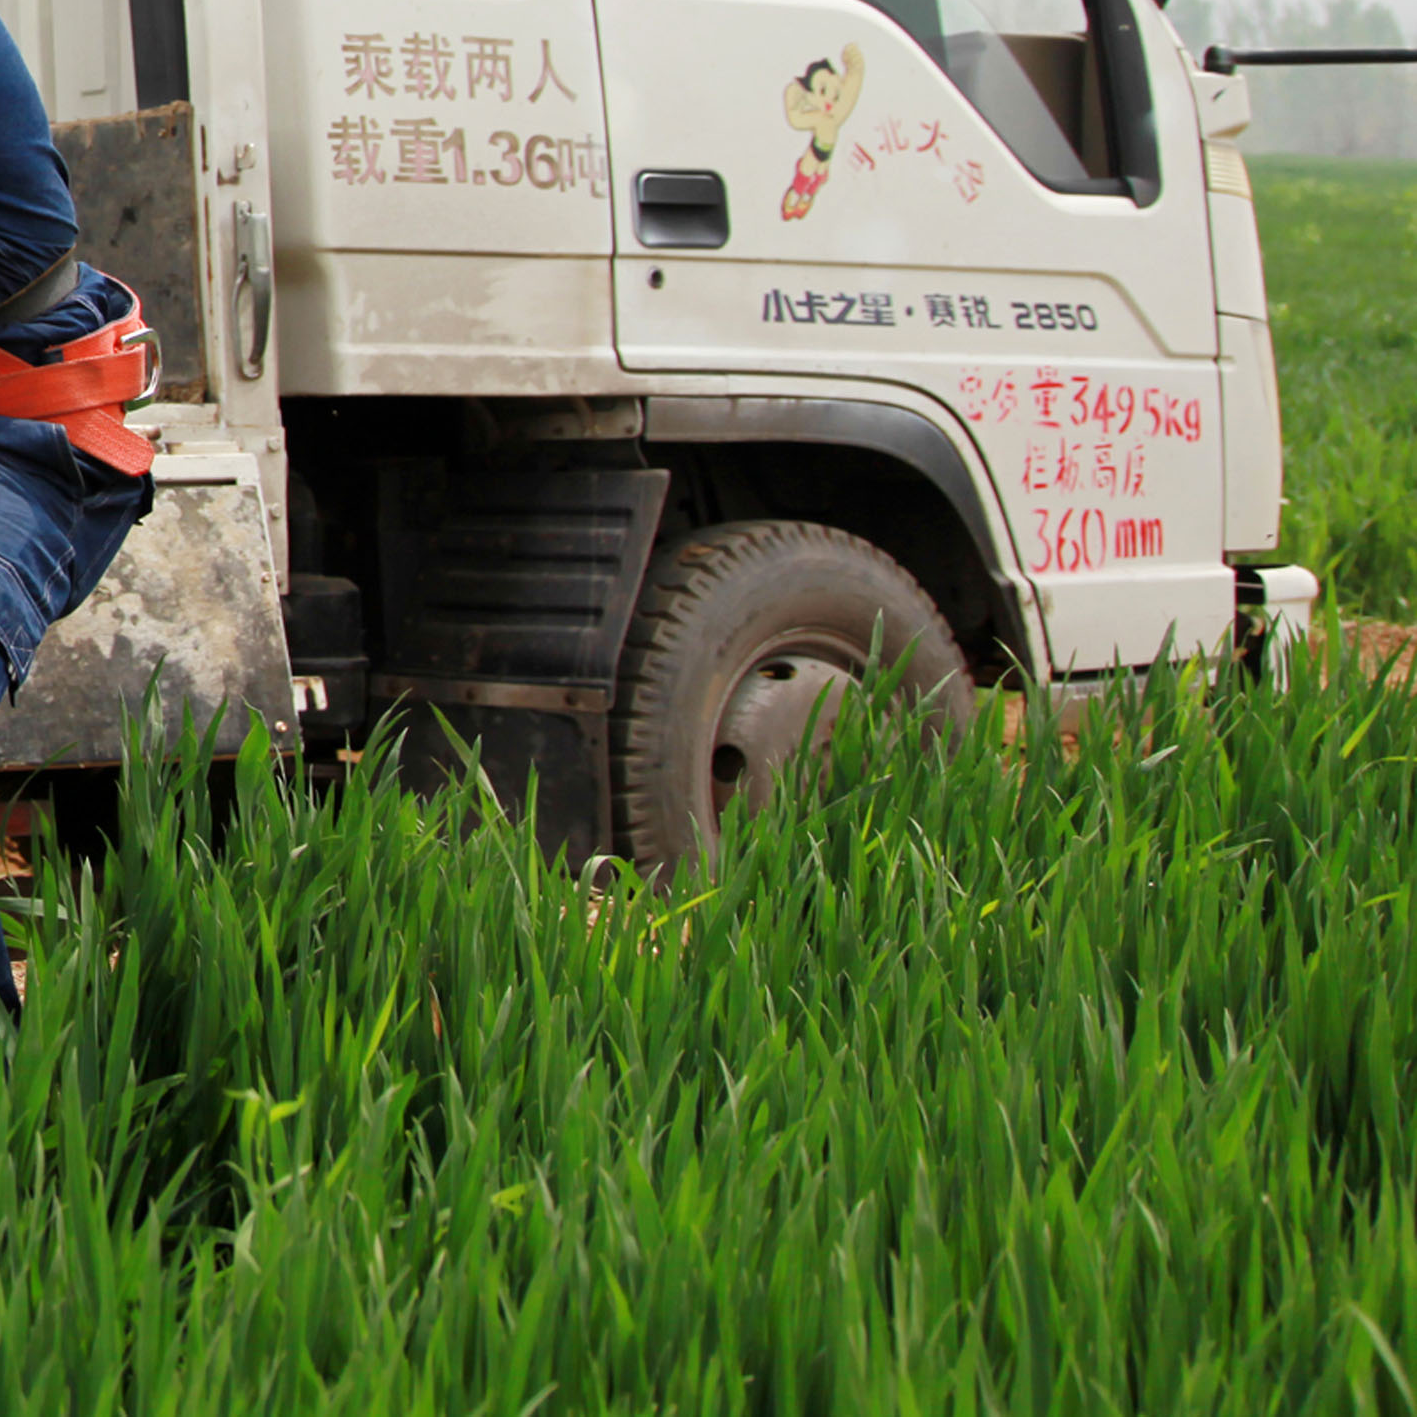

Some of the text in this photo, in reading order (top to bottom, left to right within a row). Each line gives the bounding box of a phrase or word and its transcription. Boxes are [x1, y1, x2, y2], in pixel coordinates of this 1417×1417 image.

[341, 32, 577, 103] 乘载两人
[327, 115, 609, 199] 载重1.36吨
[1011, 302, 1098, 331] 2850
[960, 365, 1201, 442] 总质量3495kg
[1021, 436, 1147, 499] 栏板高度
